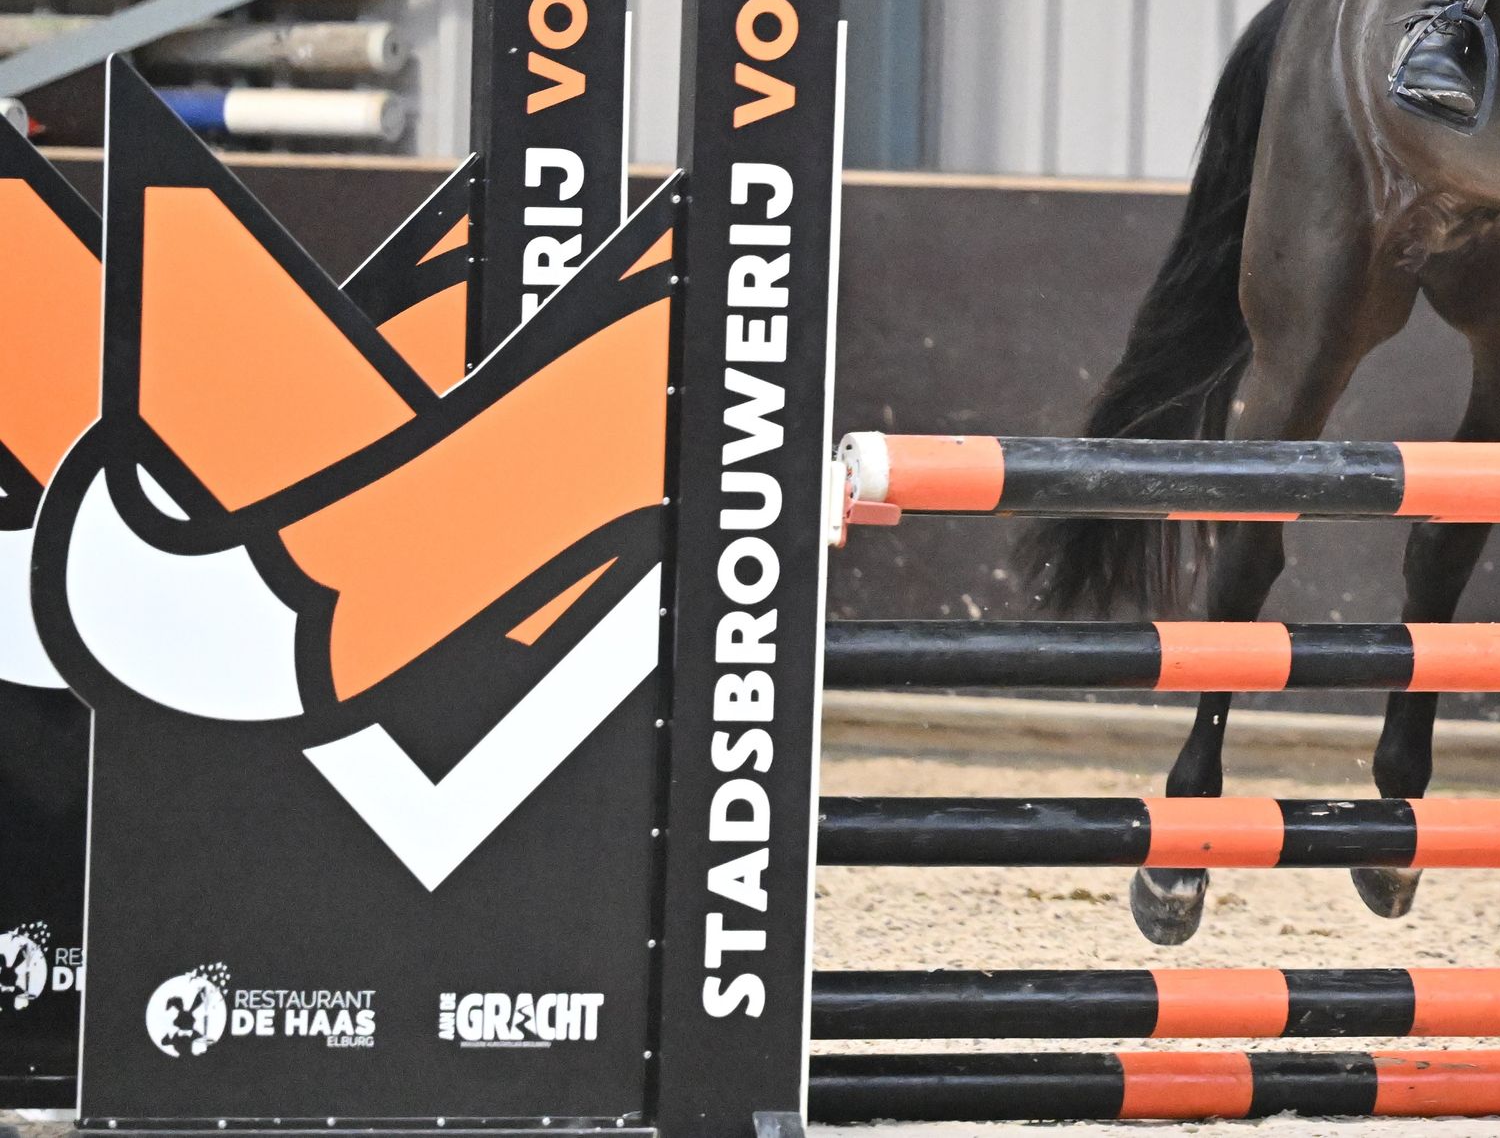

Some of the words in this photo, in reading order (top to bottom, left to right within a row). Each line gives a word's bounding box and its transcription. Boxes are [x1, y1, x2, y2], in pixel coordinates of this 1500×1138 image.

[702, 163, 794, 1018] STADSBROUWERIJ
[234, 989, 376, 1009] RESTAURANT
[231, 1009, 275, 1036] DE
[285, 1009, 376, 1036] HAAS
[456, 992, 605, 1041] GRACHT
[326, 1036, 375, 1048] ELBURG
